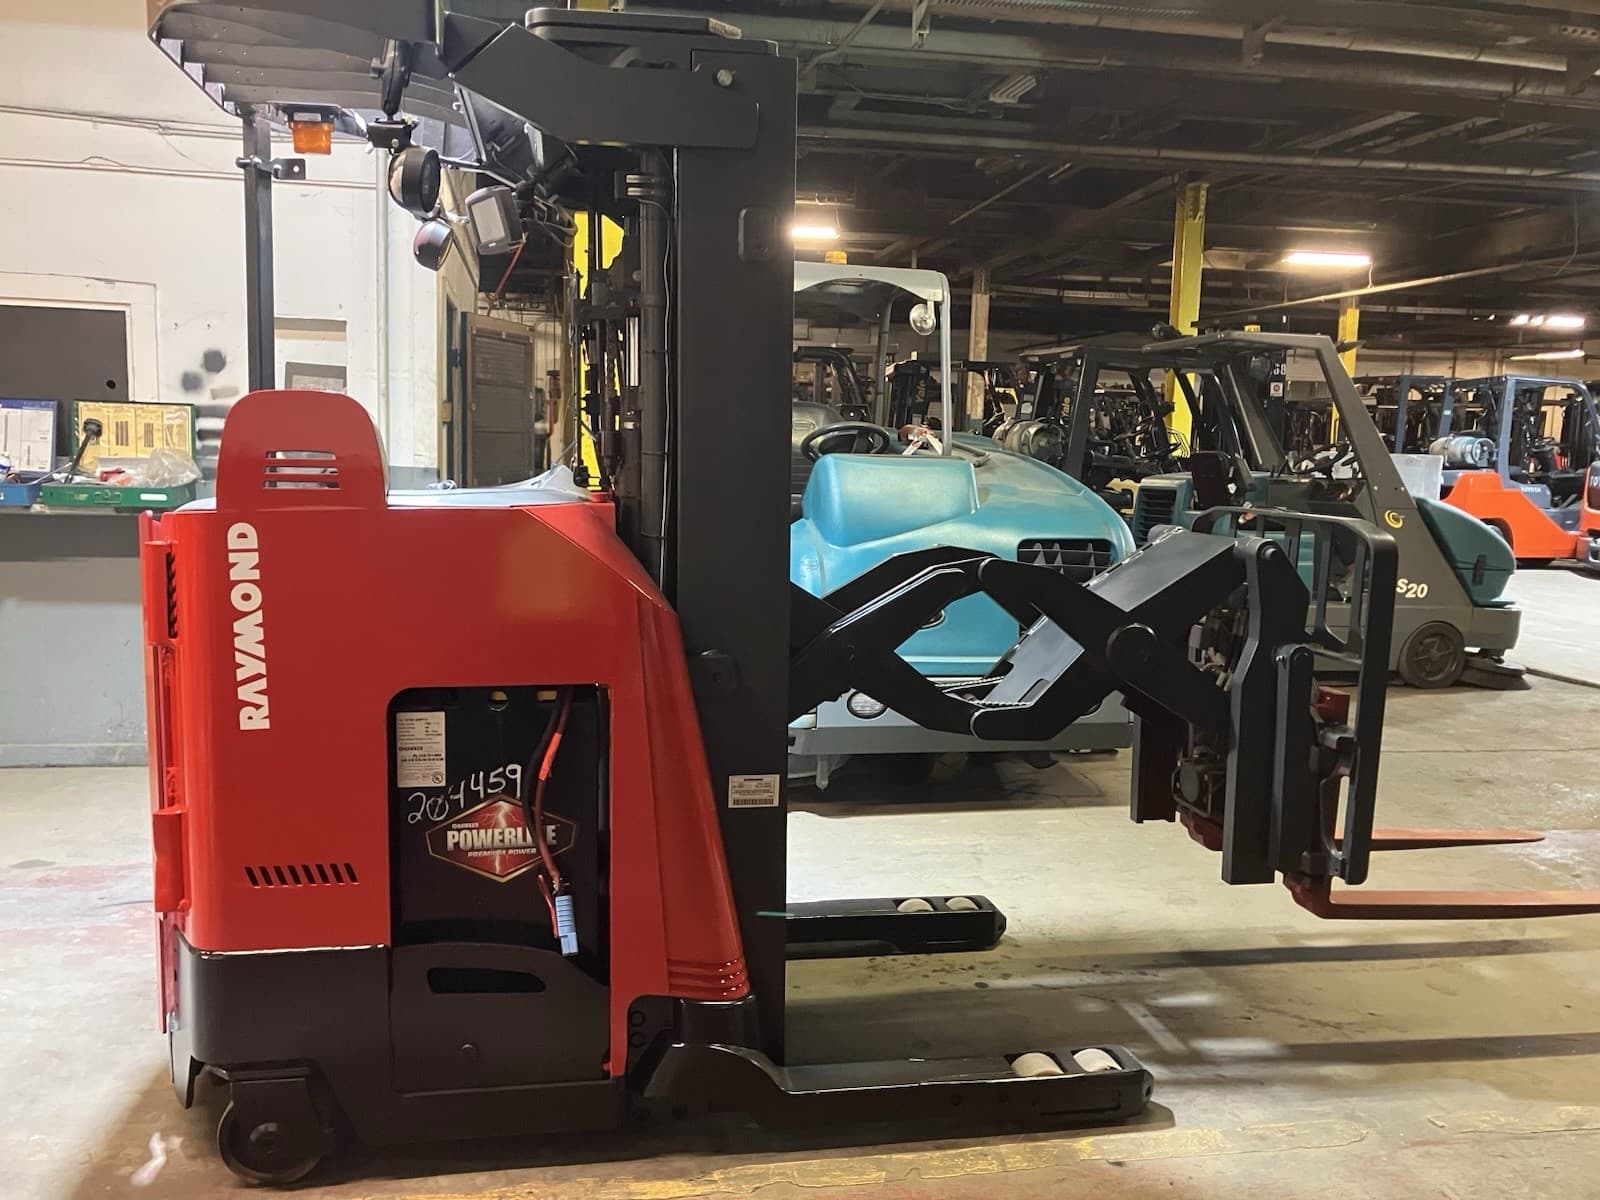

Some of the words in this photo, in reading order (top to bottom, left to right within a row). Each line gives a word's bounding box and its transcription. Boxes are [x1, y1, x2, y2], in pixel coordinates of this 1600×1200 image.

[1395, 578, 1429, 598] S20
[227, 522, 270, 731] RAYMOND
[446, 825, 558, 852] POWERLIE
[508, 847, 537, 856] POWER
